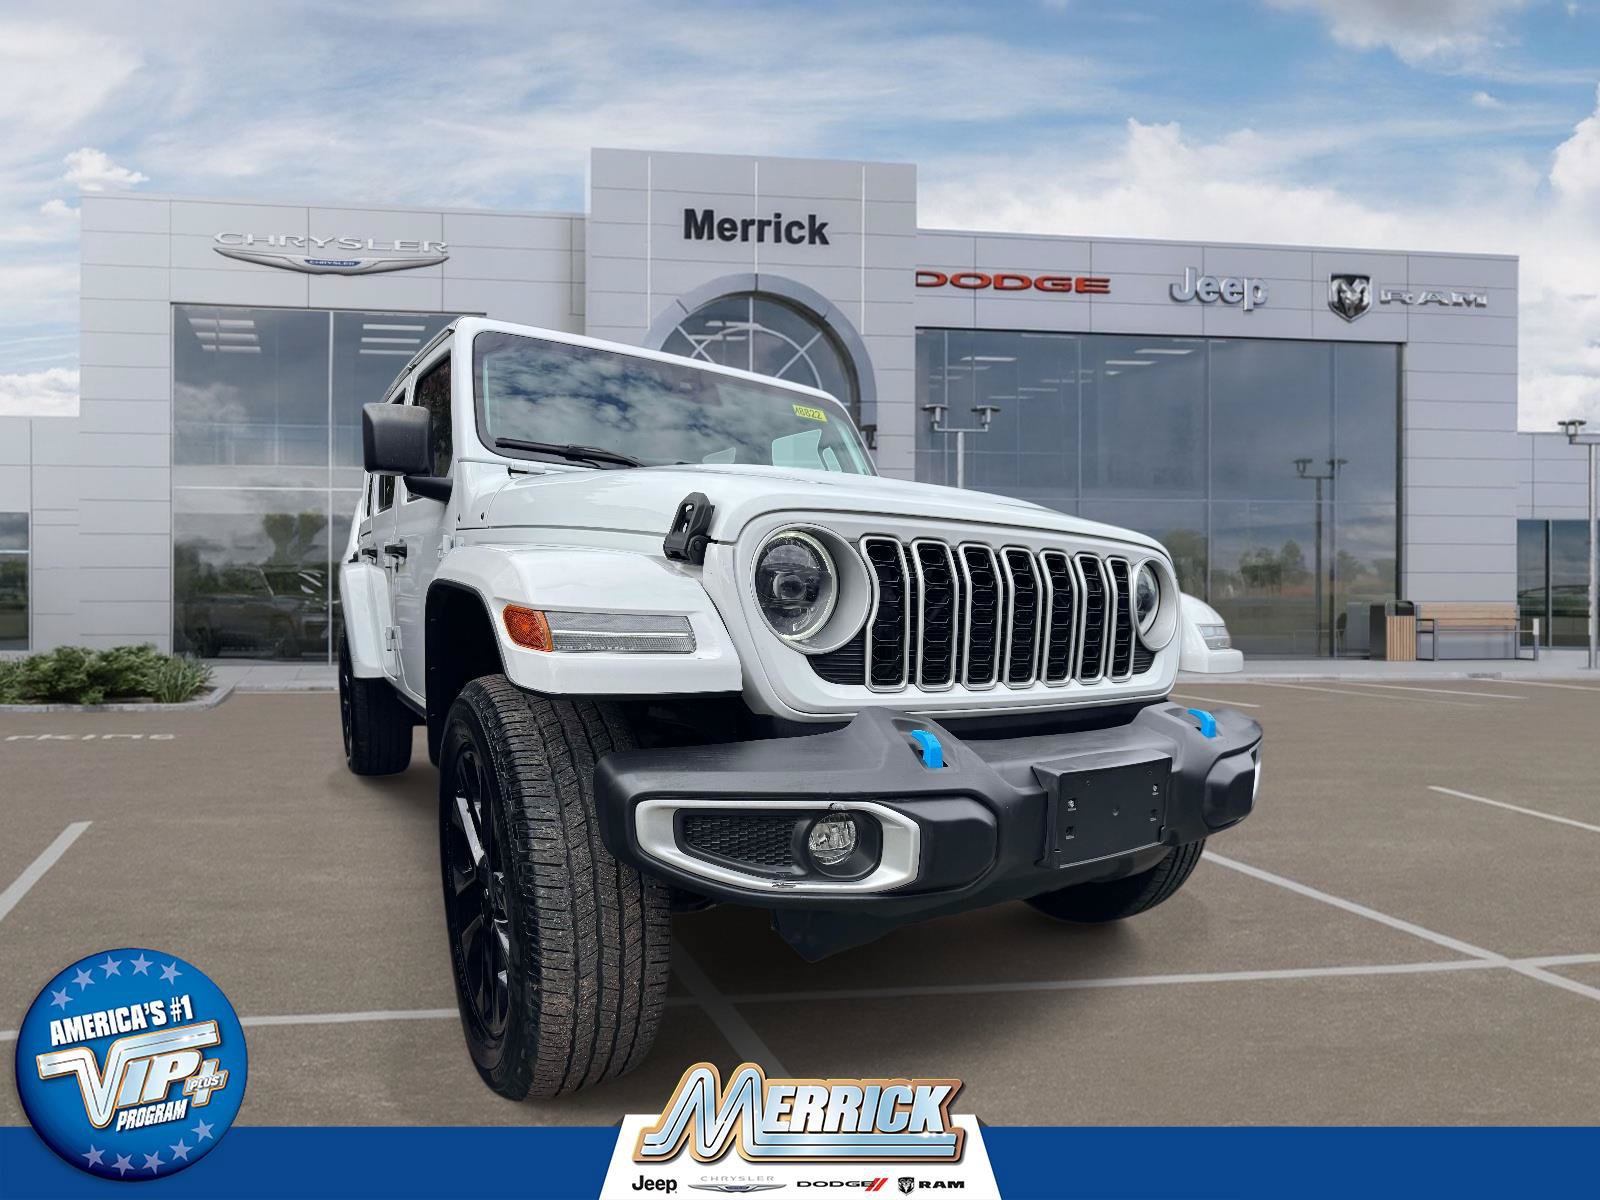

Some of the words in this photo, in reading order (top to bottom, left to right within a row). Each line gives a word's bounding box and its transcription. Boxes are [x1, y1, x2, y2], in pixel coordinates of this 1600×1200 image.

[683, 208, 830, 245] Merrick
[213, 231, 449, 254] CHRYSLER
[914, 270, 1112, 294] DODGE
[1169, 266, 1271, 312] Jeep
[1379, 288, 1488, 309] RAM
